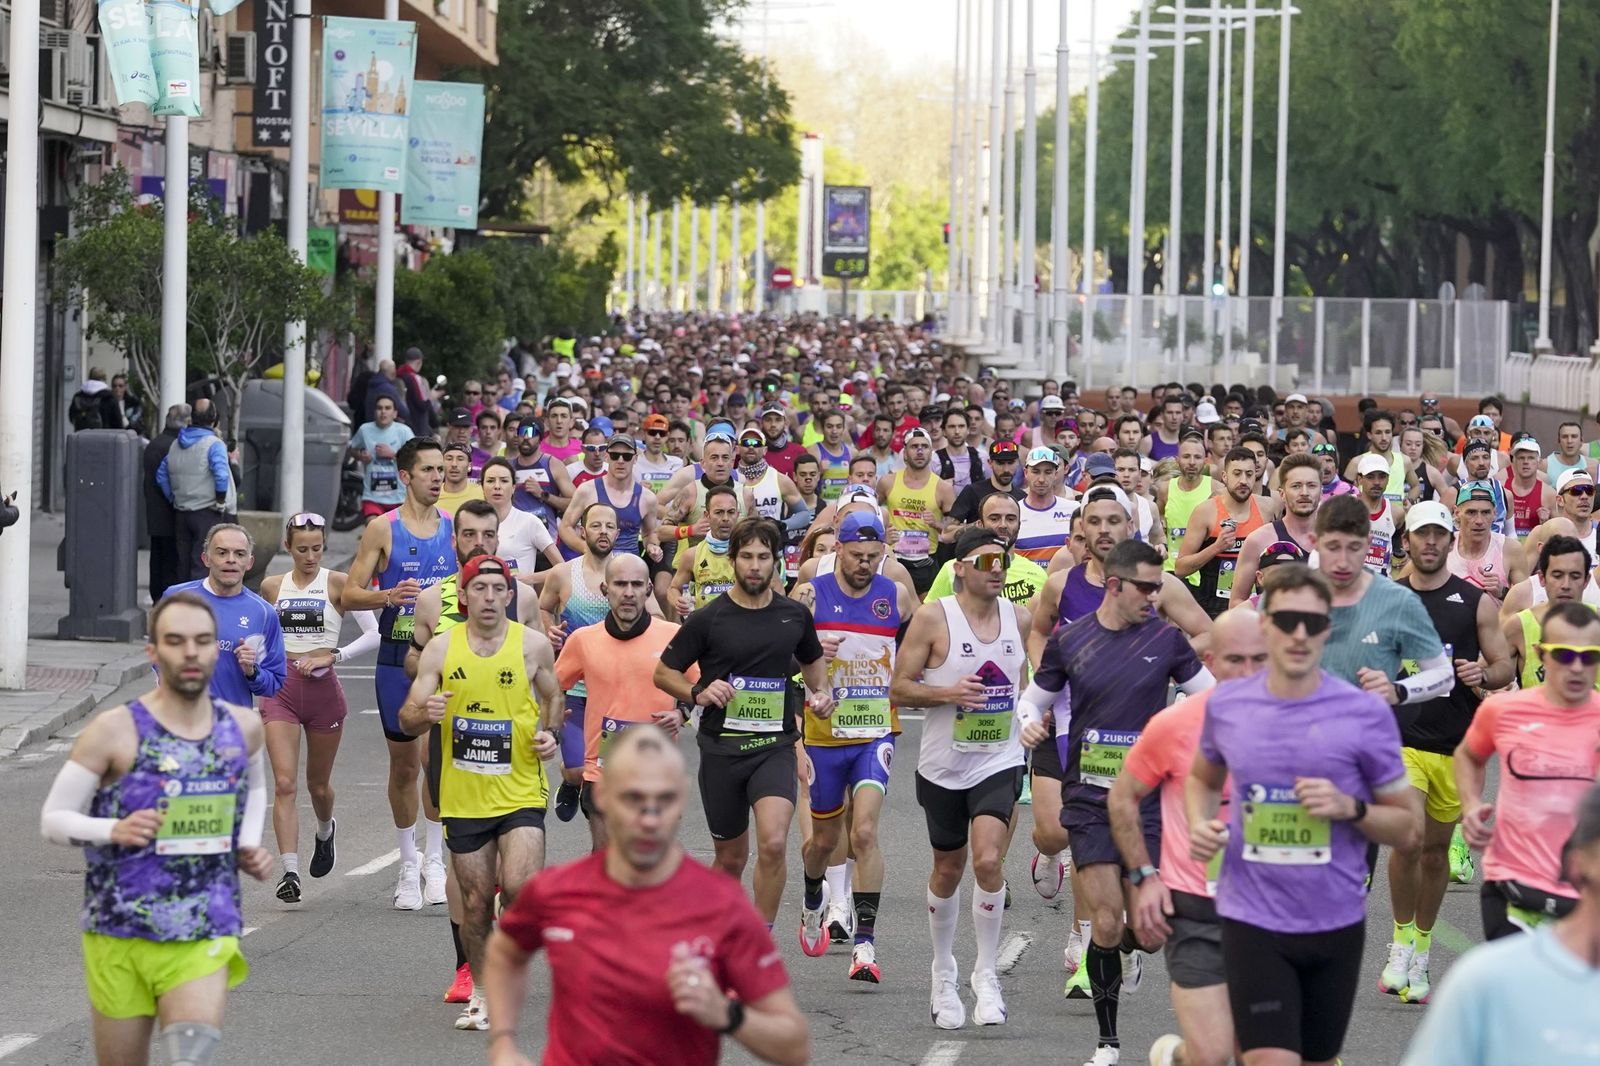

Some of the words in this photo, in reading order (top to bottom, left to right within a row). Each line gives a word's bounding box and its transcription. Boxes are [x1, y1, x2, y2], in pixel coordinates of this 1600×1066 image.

[326, 119, 405, 140] SEVILLA
[420, 156, 451, 164] SEVILLA
[755, 497, 778, 507] LAB
[901, 497, 926, 506] CORRE
[292, 600, 320, 608] ZURICH
[290, 613, 307, 621] 3689
[295, 626, 325, 634] FAUVELET
[749, 681, 780, 689] ZURICH
[851, 688, 884, 696] ZURICH
[748, 697, 766, 705] 2519
[978, 702, 1009, 711] URICH
[738, 705, 772, 719] ÁNGEL
[838, 714, 884, 726] ROMERO
[977, 719, 995, 727] 3092
[471, 722, 505, 731] ZURICH
[966, 729, 1002, 741] JORGE
[471, 738, 490, 747] 4340
[463, 748, 499, 762] JAIME
[185, 780, 229, 793] ZURICH
[1259, 828, 1312, 844] PAULO
